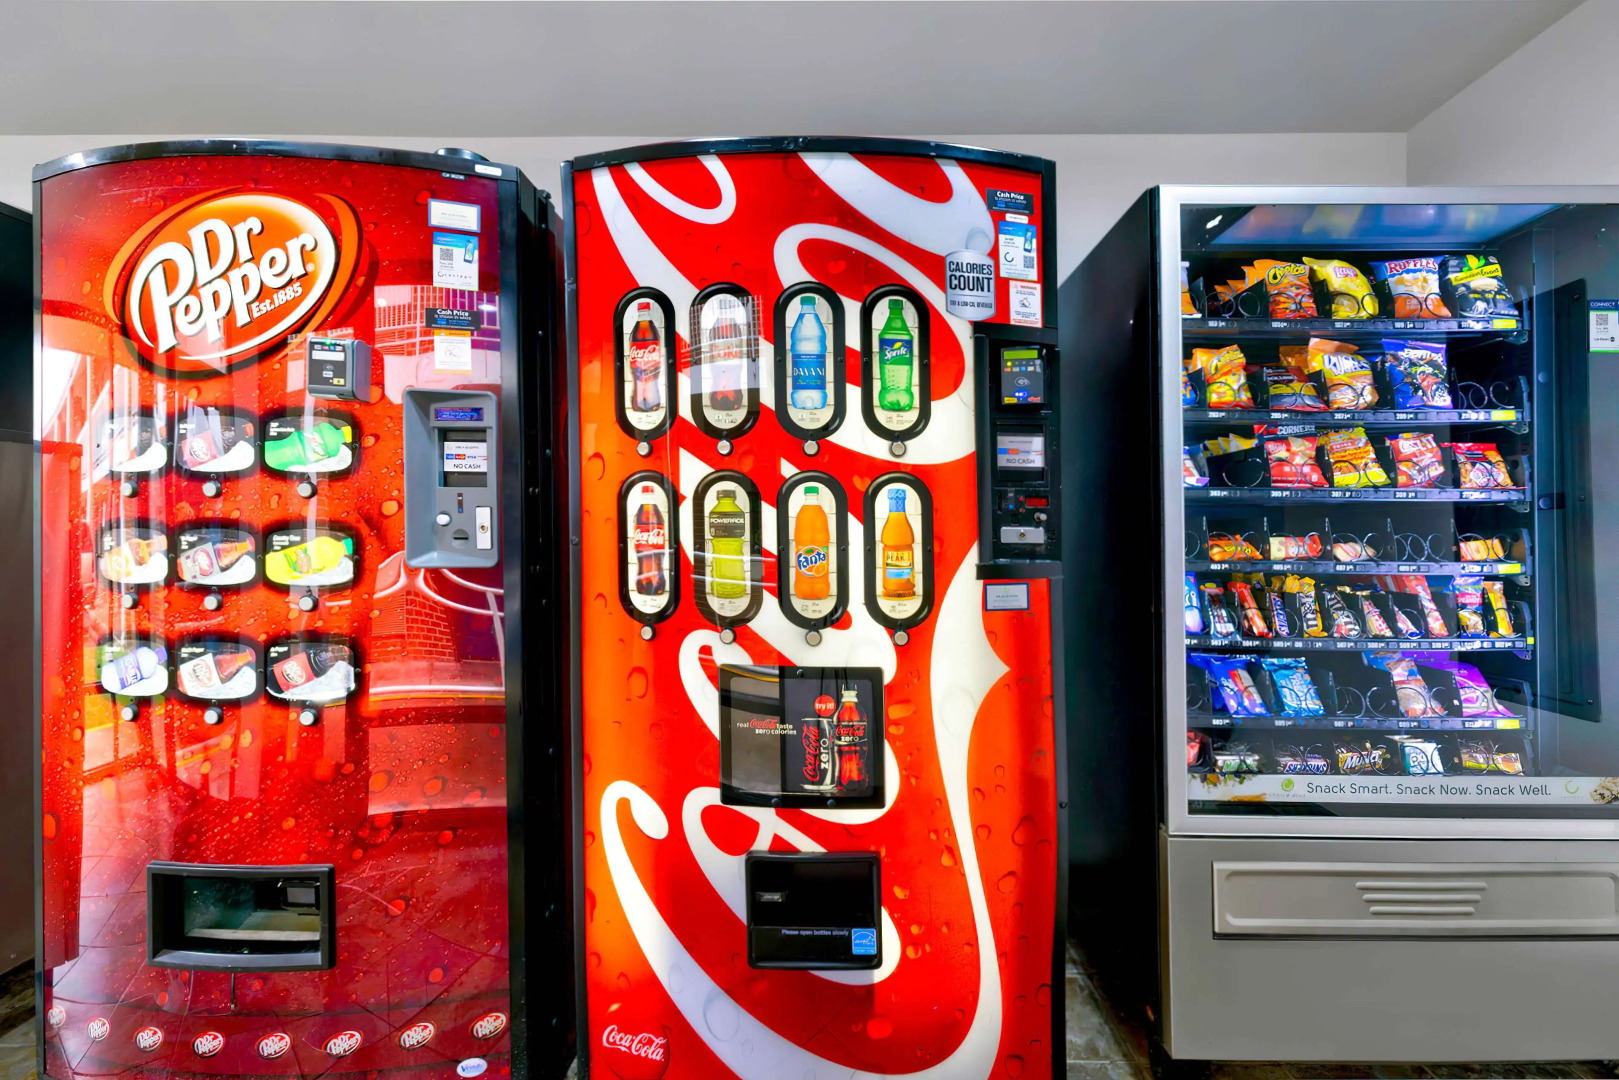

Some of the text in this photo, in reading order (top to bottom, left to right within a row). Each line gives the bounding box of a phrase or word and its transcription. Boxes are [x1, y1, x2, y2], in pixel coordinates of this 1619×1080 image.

[187, 216, 265, 286] Dr
[948, 261, 992, 276] CALORIES
[1266, 263, 1309, 285] Cheetos
[949, 274, 992, 292] COUNT
[129, 231, 318, 354] Pepper
[630, 344, 660, 362] Coca-Cola
[884, 346, 907, 360] Sprite
[634, 528, 664, 545] Coca-Cola
[797, 550, 826, 571] Fanta
[749, 718, 778, 729] Coca-Cola
[835, 724, 865, 737] Coca-Cola
[802, 724, 820, 782] Coca-Cola
[820, 738, 829, 770] zero
[1307, 782, 1551, 796] Snack Smart. Snack Now. Snack Well.
[474, 1018, 505, 1038] Pepper
[137, 1032, 162, 1048] Pepper
[195, 1038, 222, 1055] Pepper
[328, 1037, 360, 1056] Pepper
[401, 1028, 432, 1047] Pepper
[602, 1024, 668, 1062] Coca-Cola
[260, 1039, 289, 1057] Pepper
